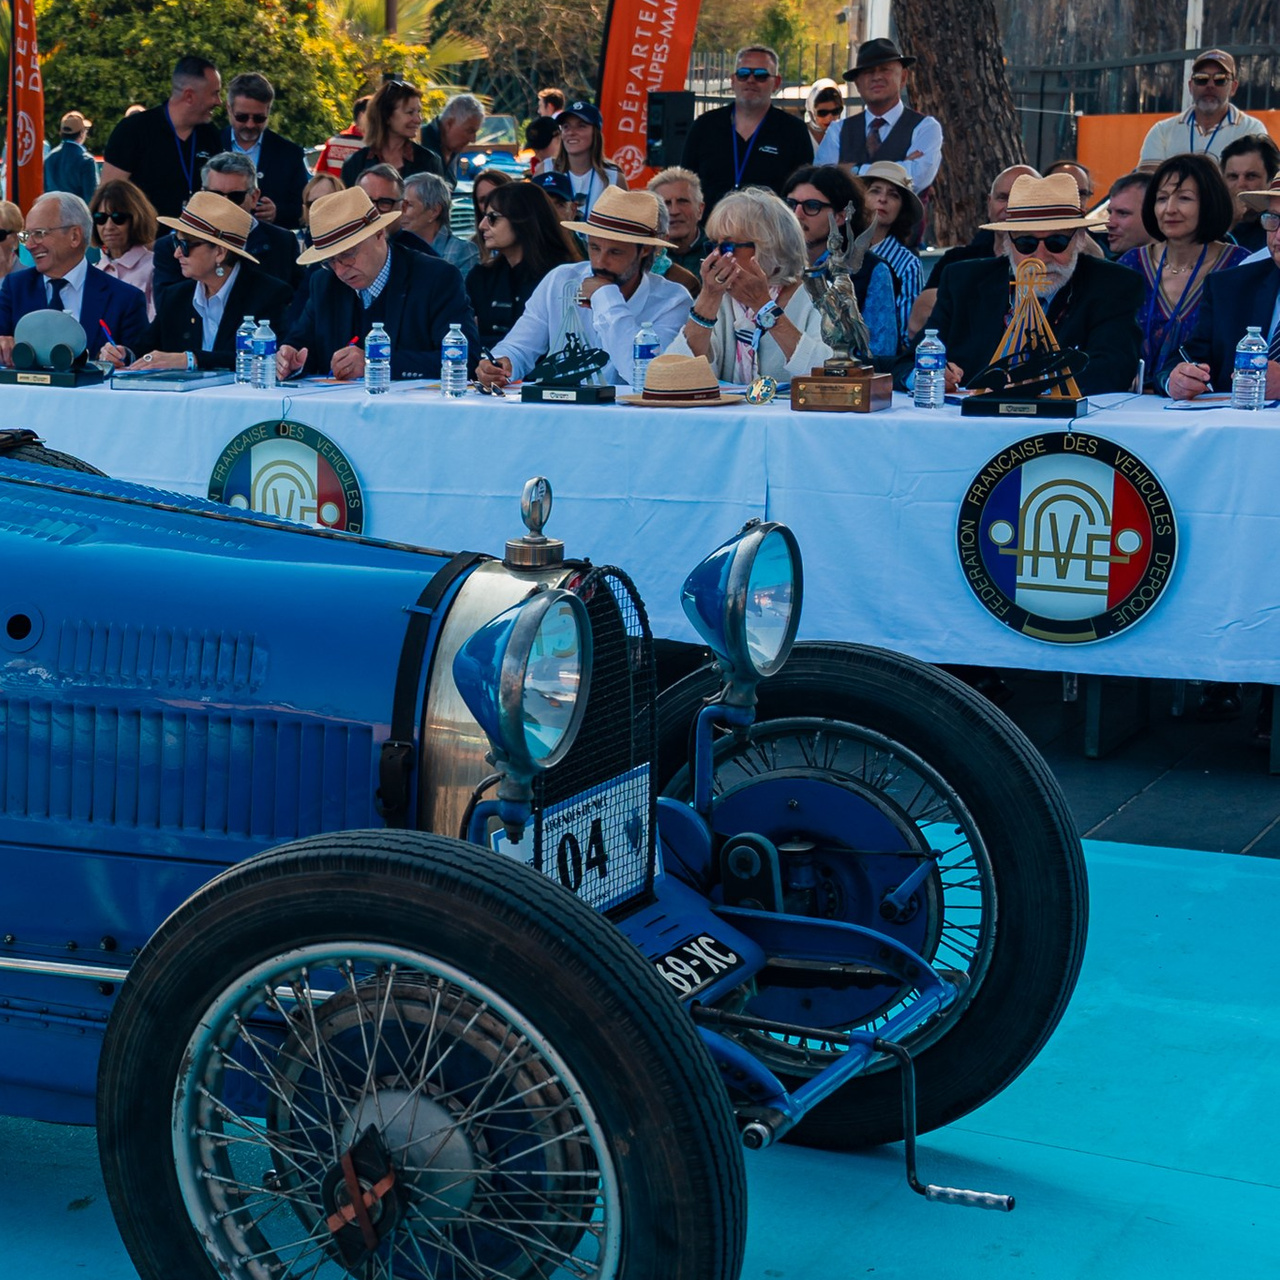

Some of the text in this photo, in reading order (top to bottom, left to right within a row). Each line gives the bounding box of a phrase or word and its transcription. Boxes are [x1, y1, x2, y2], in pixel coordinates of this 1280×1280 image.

[279, 422, 306, 440] DES
[315, 436, 361, 510] VEHICULES
[960, 434, 1172, 627] FEDERATION FRANÇAISE DES VEHICULES D'EPOQUE
[557, 816, 609, 893] 04
